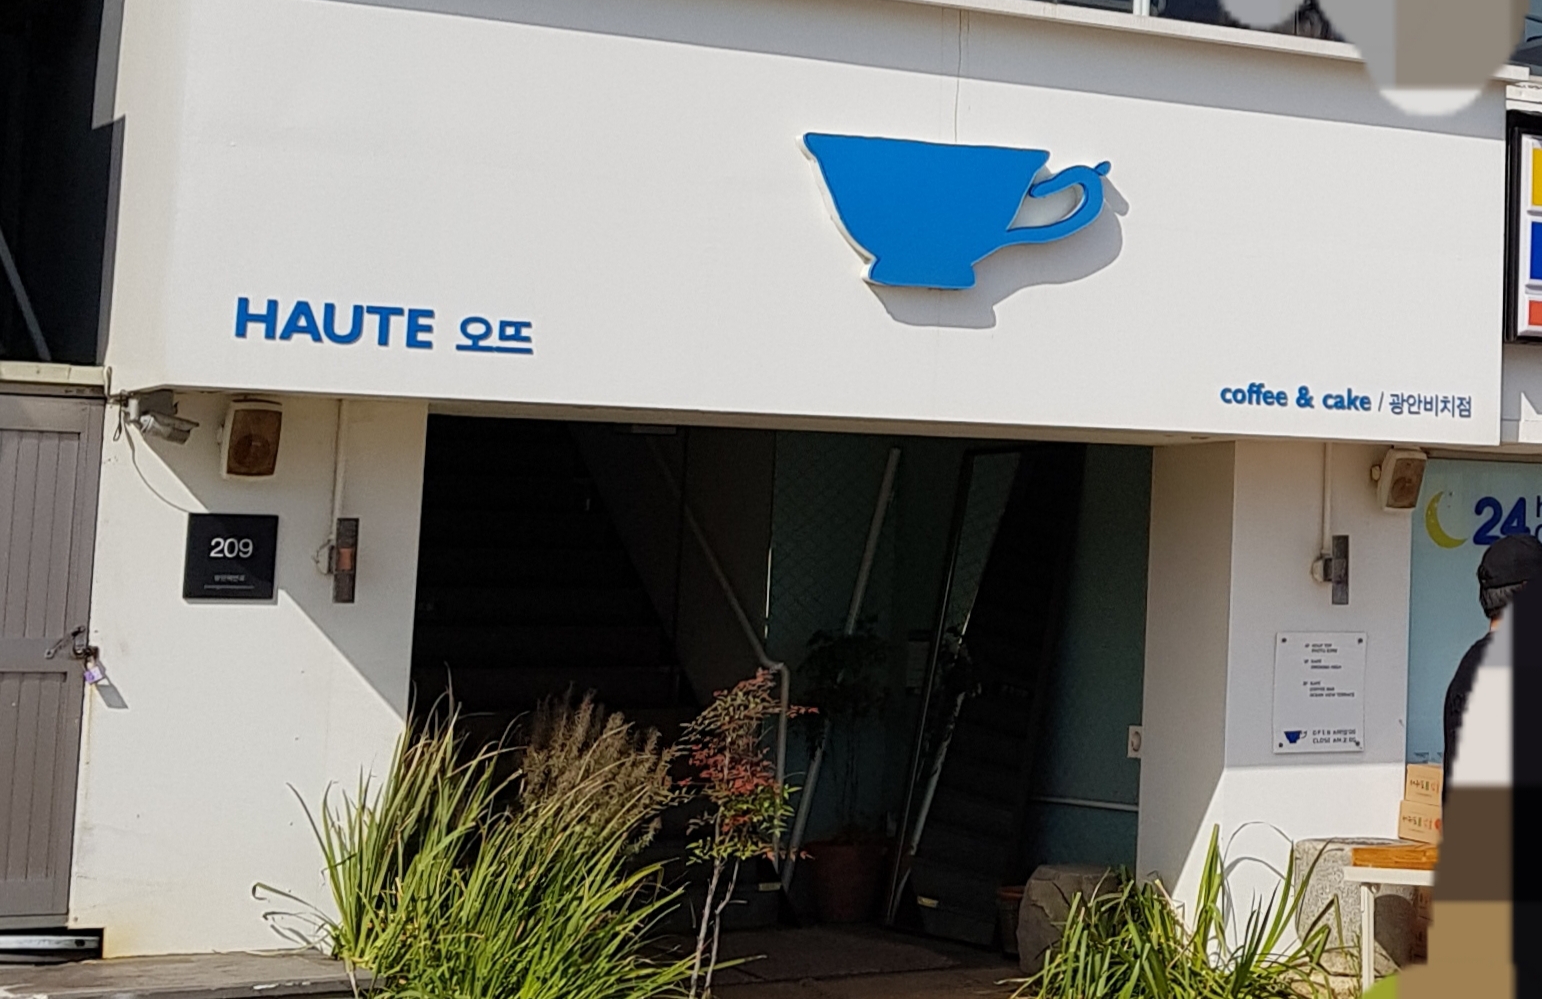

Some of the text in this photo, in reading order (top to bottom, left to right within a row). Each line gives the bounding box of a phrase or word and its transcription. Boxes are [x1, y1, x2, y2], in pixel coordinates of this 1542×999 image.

[235, 297, 435, 349] HAUTE
[1220, 383, 1288, 406] coffee
[1296, 386, 1314, 408] &
[1322, 388, 1372, 412] cake
[1389, 392, 1473, 418] 광안비치점
[1473, 496, 1530, 545] 24
[209, 537, 254, 558] 209
